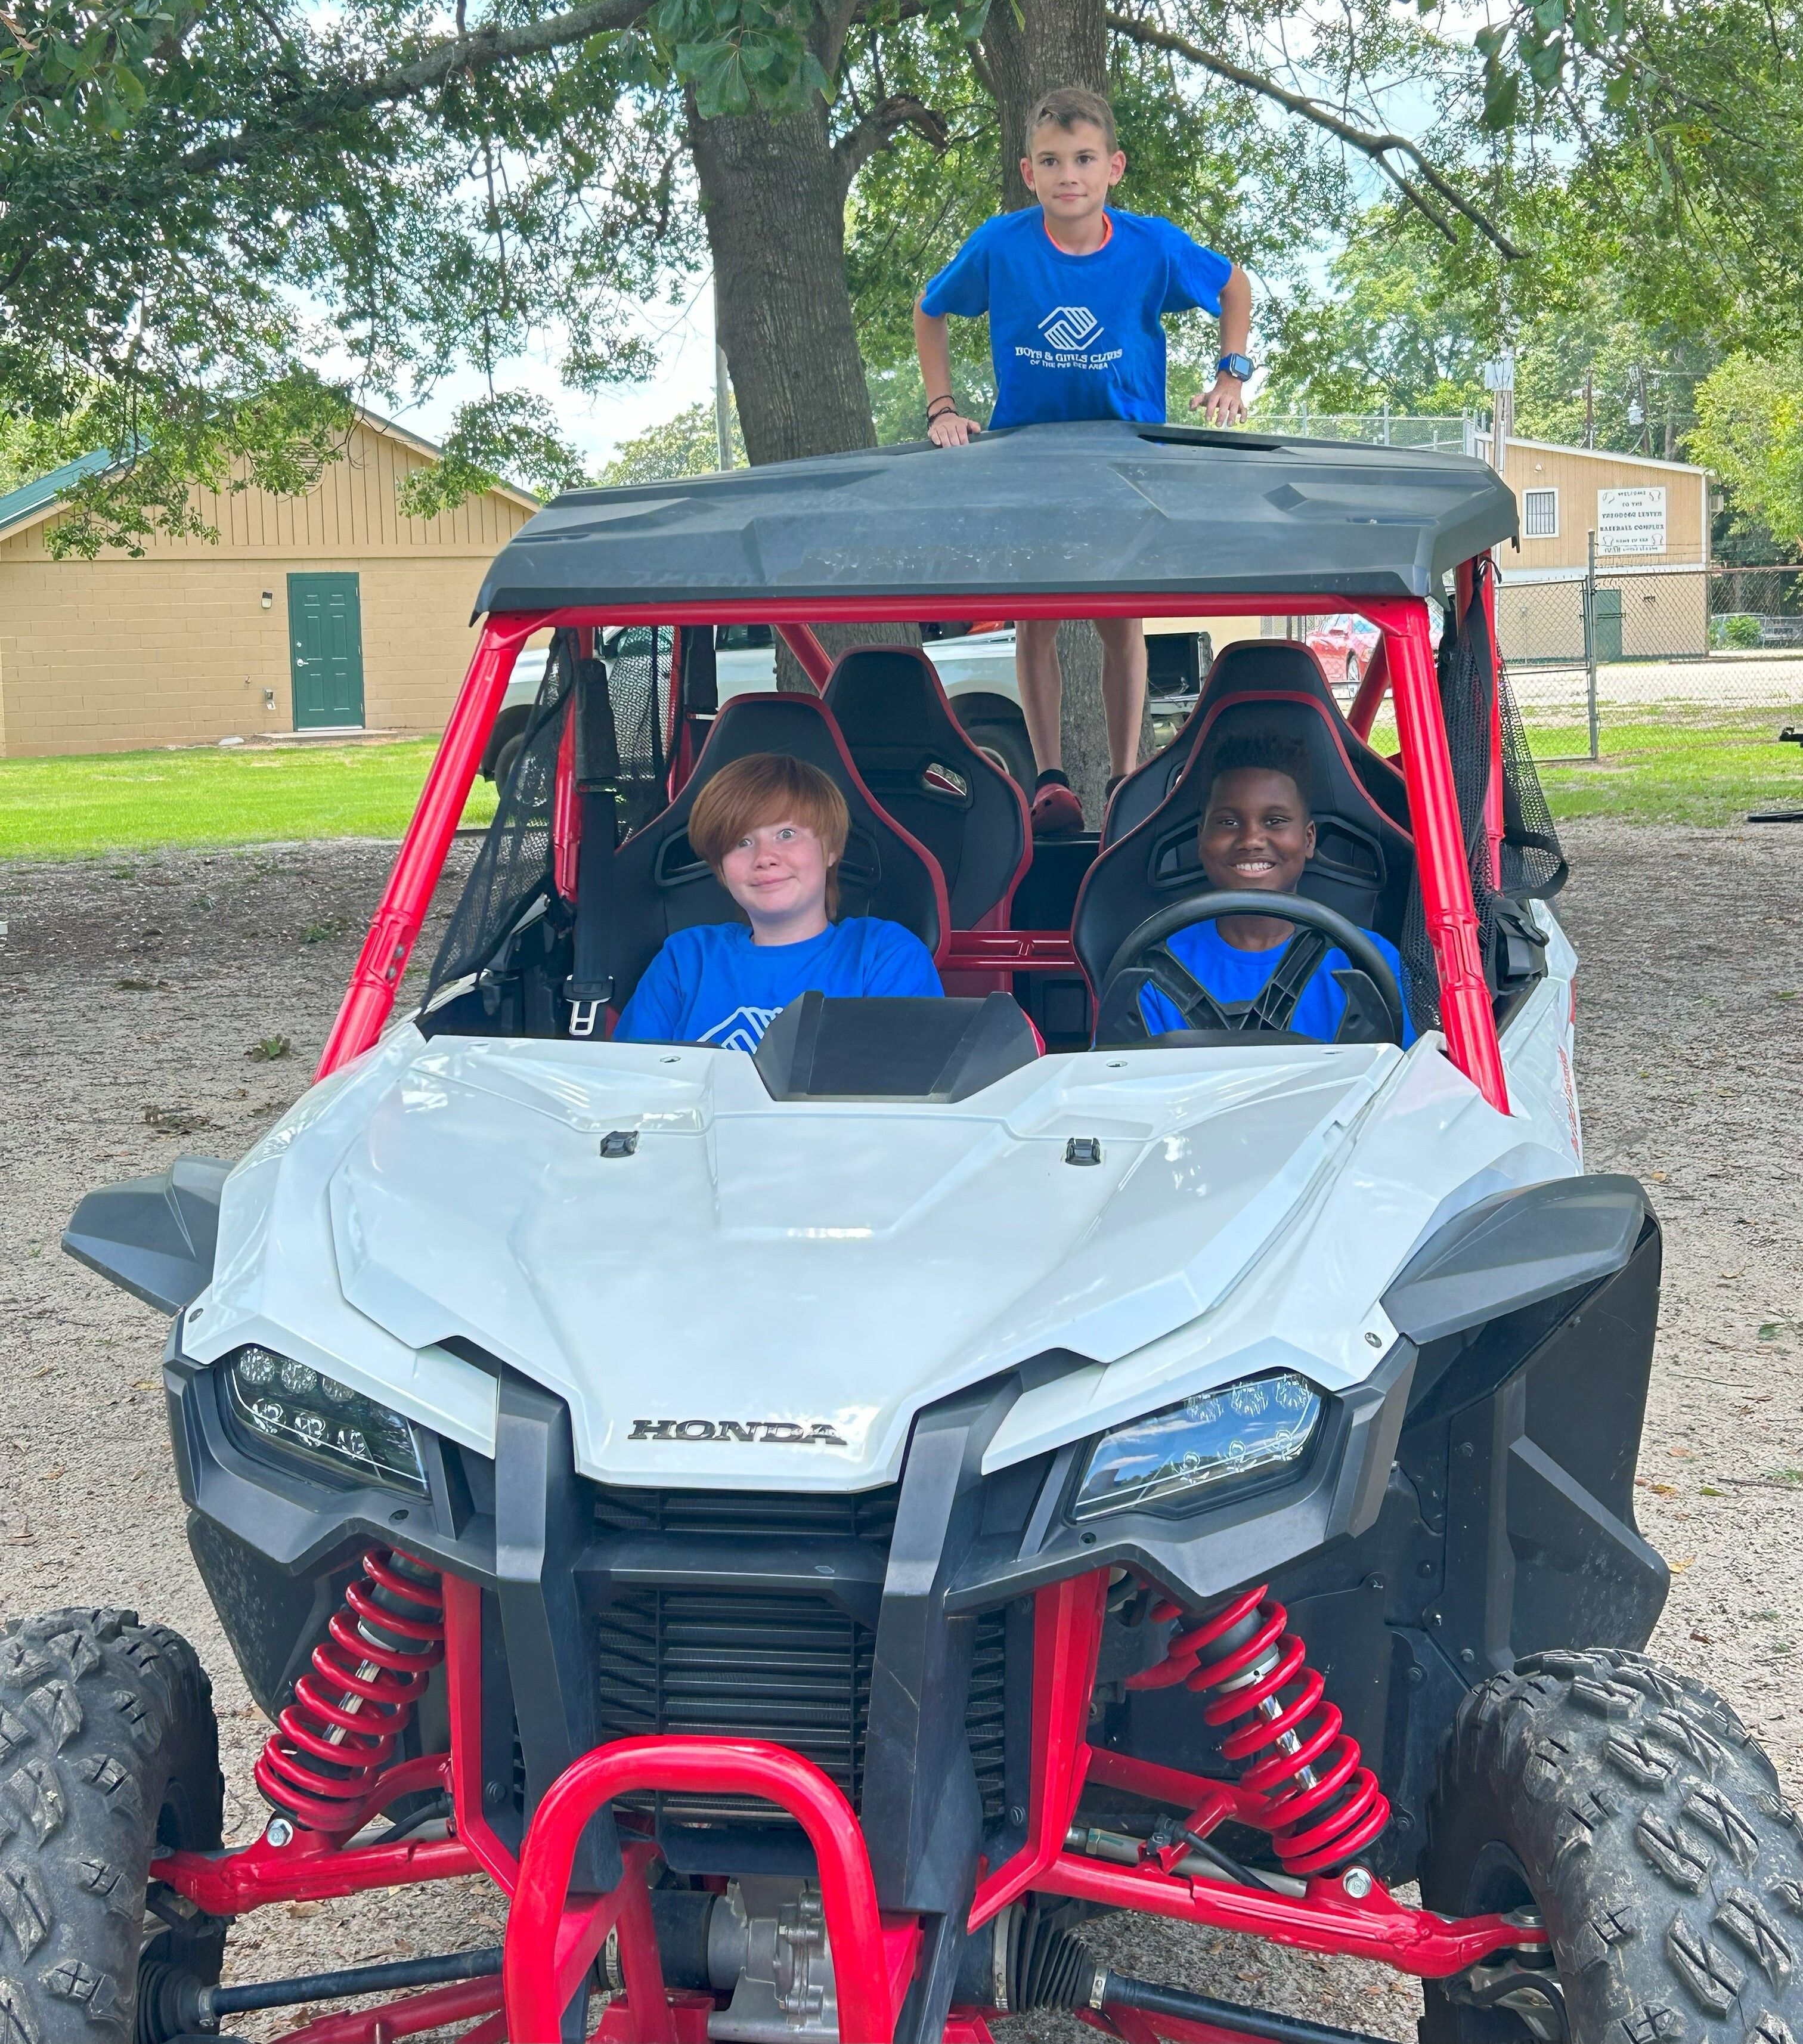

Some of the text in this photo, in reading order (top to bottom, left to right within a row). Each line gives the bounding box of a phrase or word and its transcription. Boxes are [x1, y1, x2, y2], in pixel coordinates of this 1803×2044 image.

[1015, 346, 1123, 363] BOYS & GIRLS CLUBS
[627, 1419, 848, 1446] HONDA
